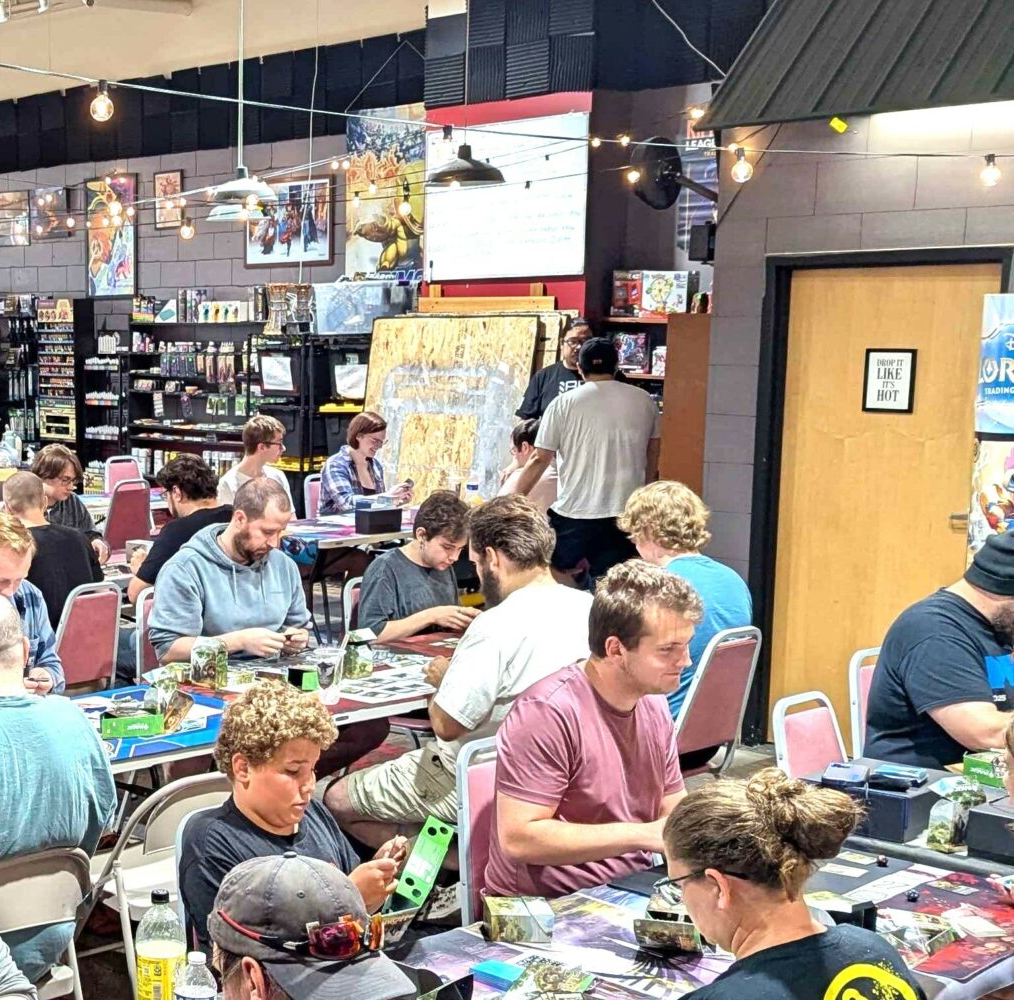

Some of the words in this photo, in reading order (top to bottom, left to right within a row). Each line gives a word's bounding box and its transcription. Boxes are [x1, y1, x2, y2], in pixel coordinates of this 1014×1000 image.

[876, 359, 896, 367] DROP
[897, 359, 904, 367] IT
[877, 367, 902, 380] LIKE
[882, 381, 895, 389] IT'S
[877, 389, 899, 402] HOT
